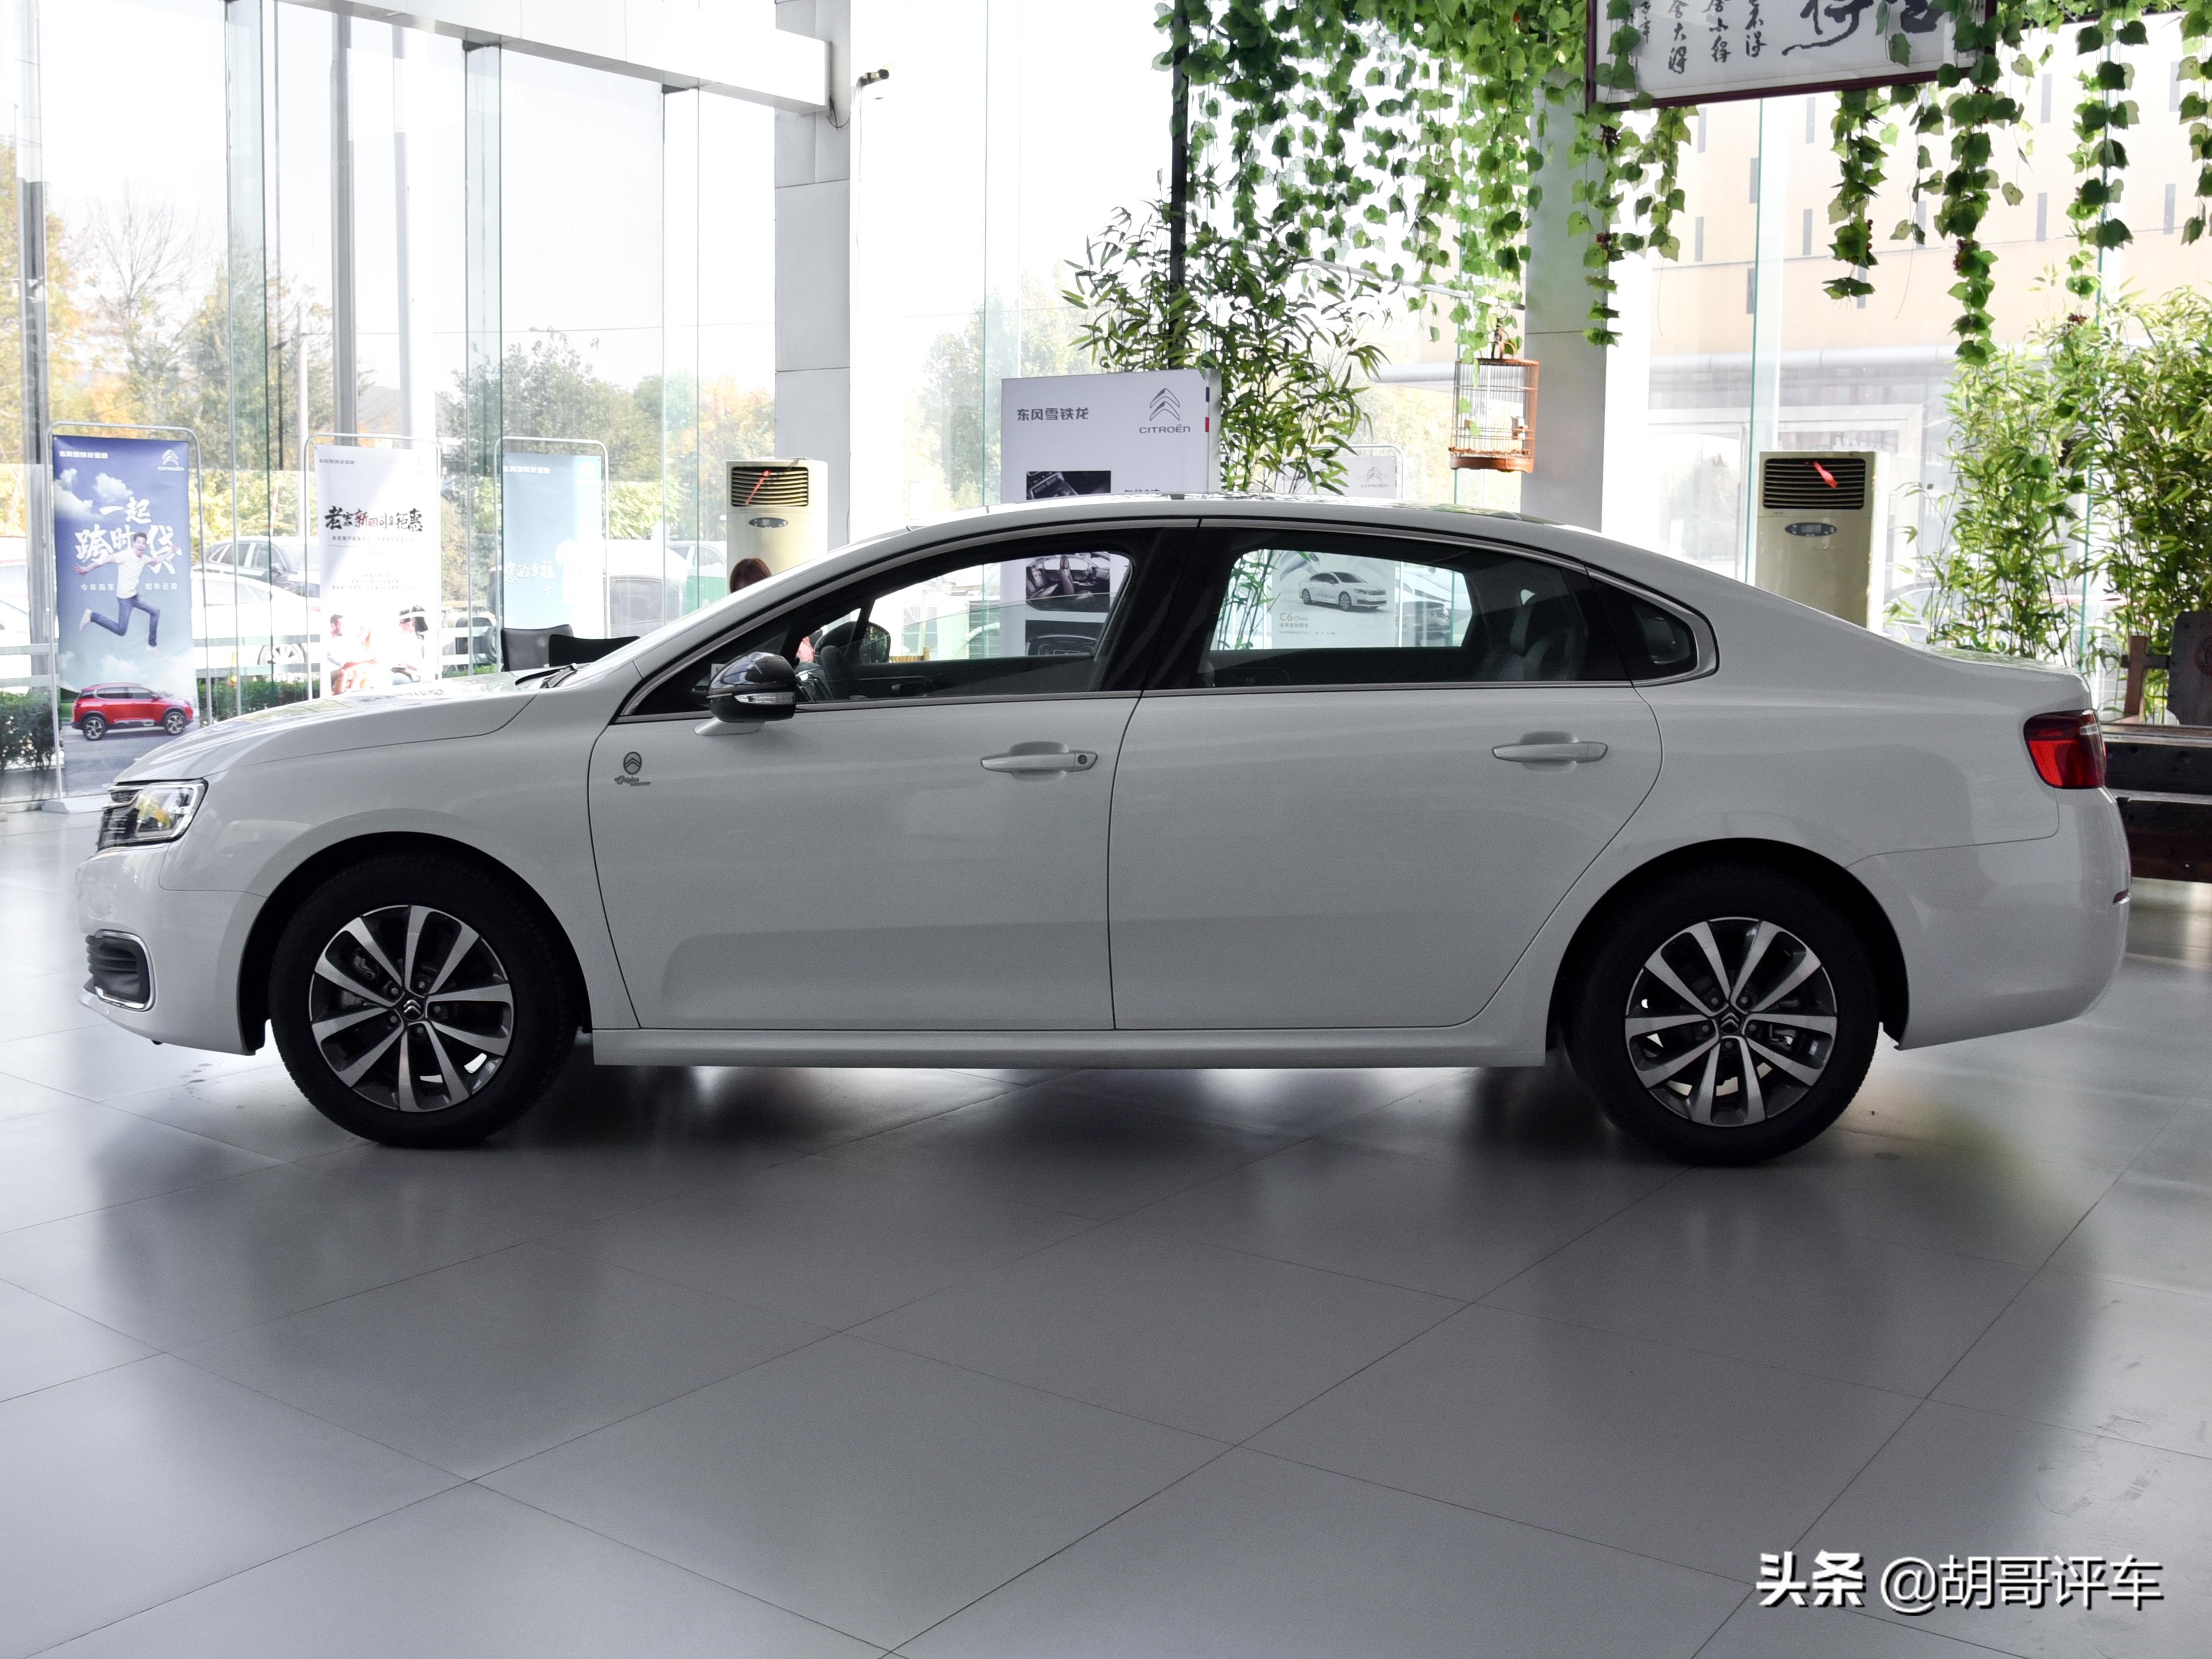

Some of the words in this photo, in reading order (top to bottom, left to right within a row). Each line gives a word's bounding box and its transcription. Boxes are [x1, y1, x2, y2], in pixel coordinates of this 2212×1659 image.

[1017, 407, 1089, 421] 东风雪铁龙
[99, 496, 152, 524] 一起
[1279, 612, 1293, 621] C6
